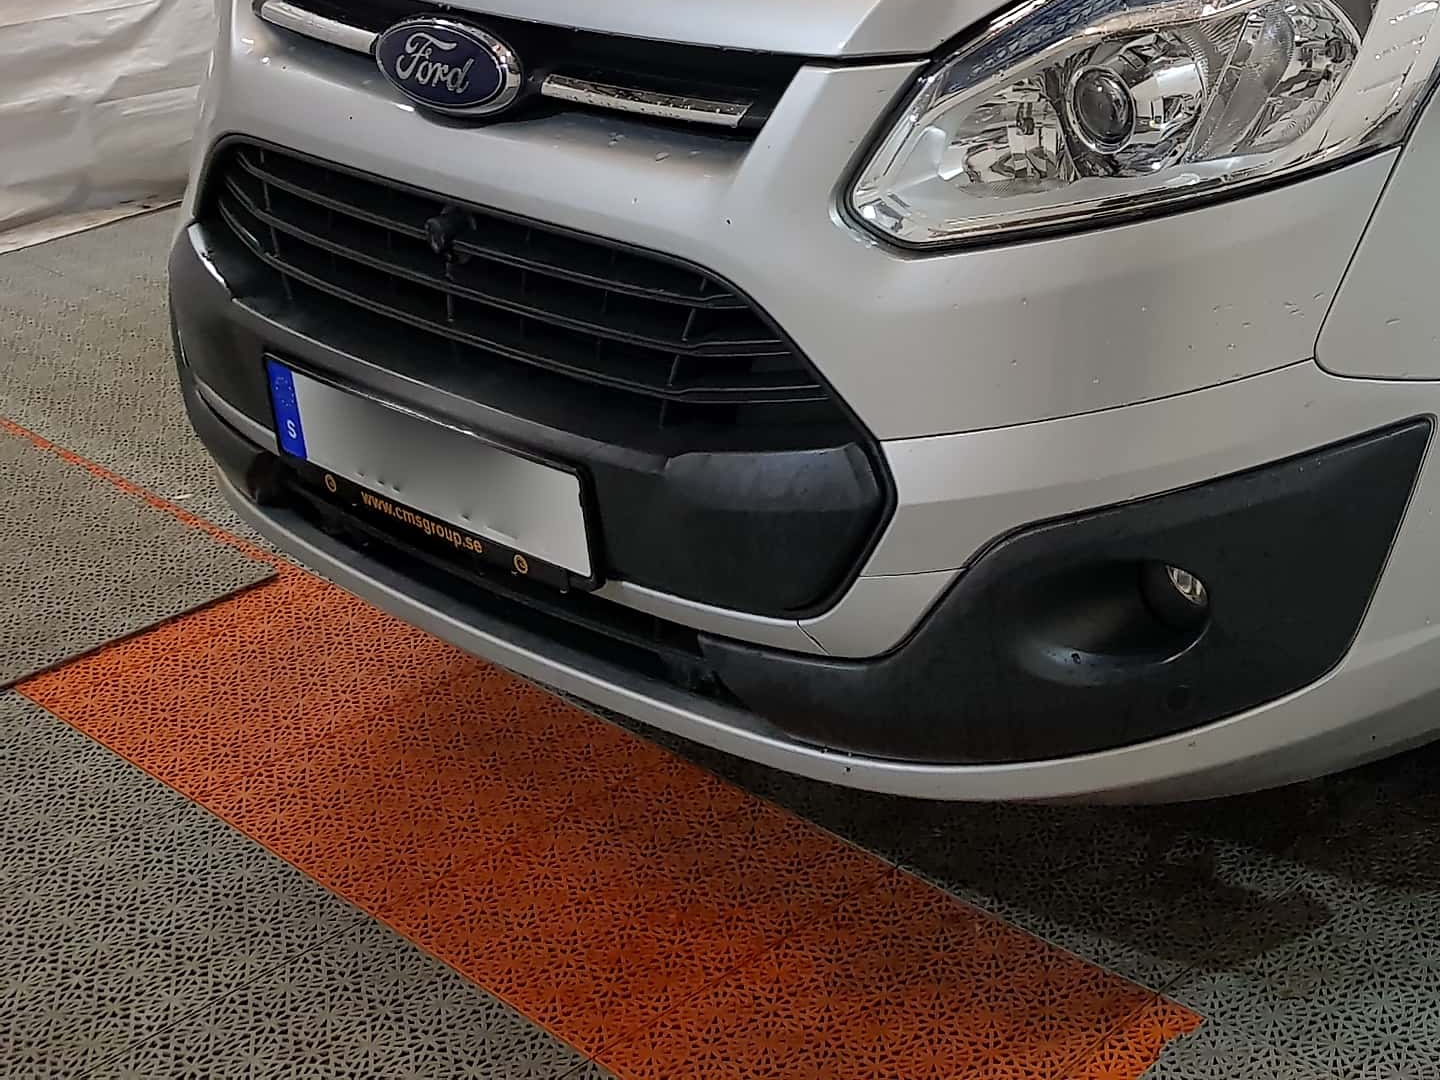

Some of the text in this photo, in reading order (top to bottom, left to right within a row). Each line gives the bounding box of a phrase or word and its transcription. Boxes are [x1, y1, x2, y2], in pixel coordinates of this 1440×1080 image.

[396, 32, 475, 94] Ford
[287, 419, 298, 440] S
[360, 490, 484, 554] www.cmsgroup.se
